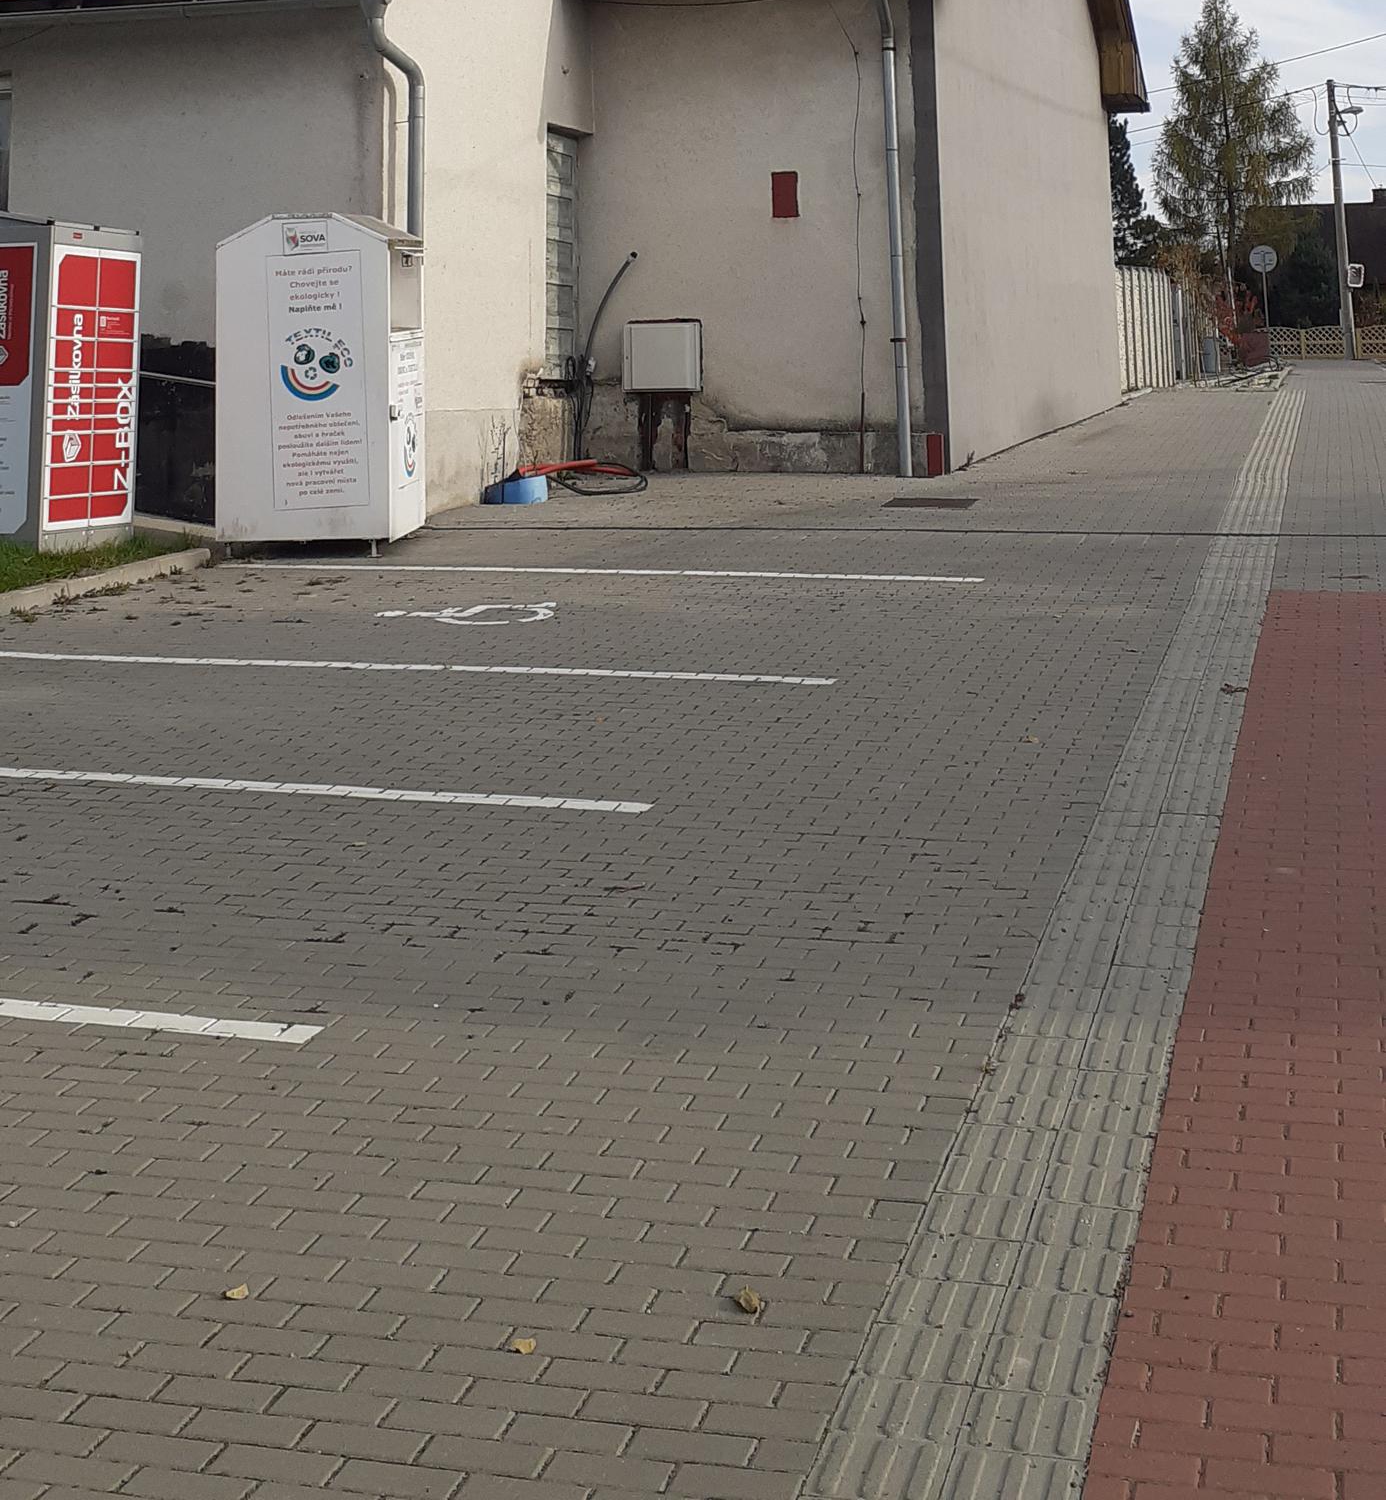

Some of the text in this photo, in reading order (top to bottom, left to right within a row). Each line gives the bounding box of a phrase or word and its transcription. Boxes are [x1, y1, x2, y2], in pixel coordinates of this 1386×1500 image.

[300, 233, 326, 243] SOVA
[289, 280, 327, 288] Chovejte
[289, 291, 335, 301] ekologicky
[285, 327, 354, 368] TEXTIL ECO
[67, 313, 84, 420] Zásilkovna
[113, 377, 133, 491] Z-BOX
